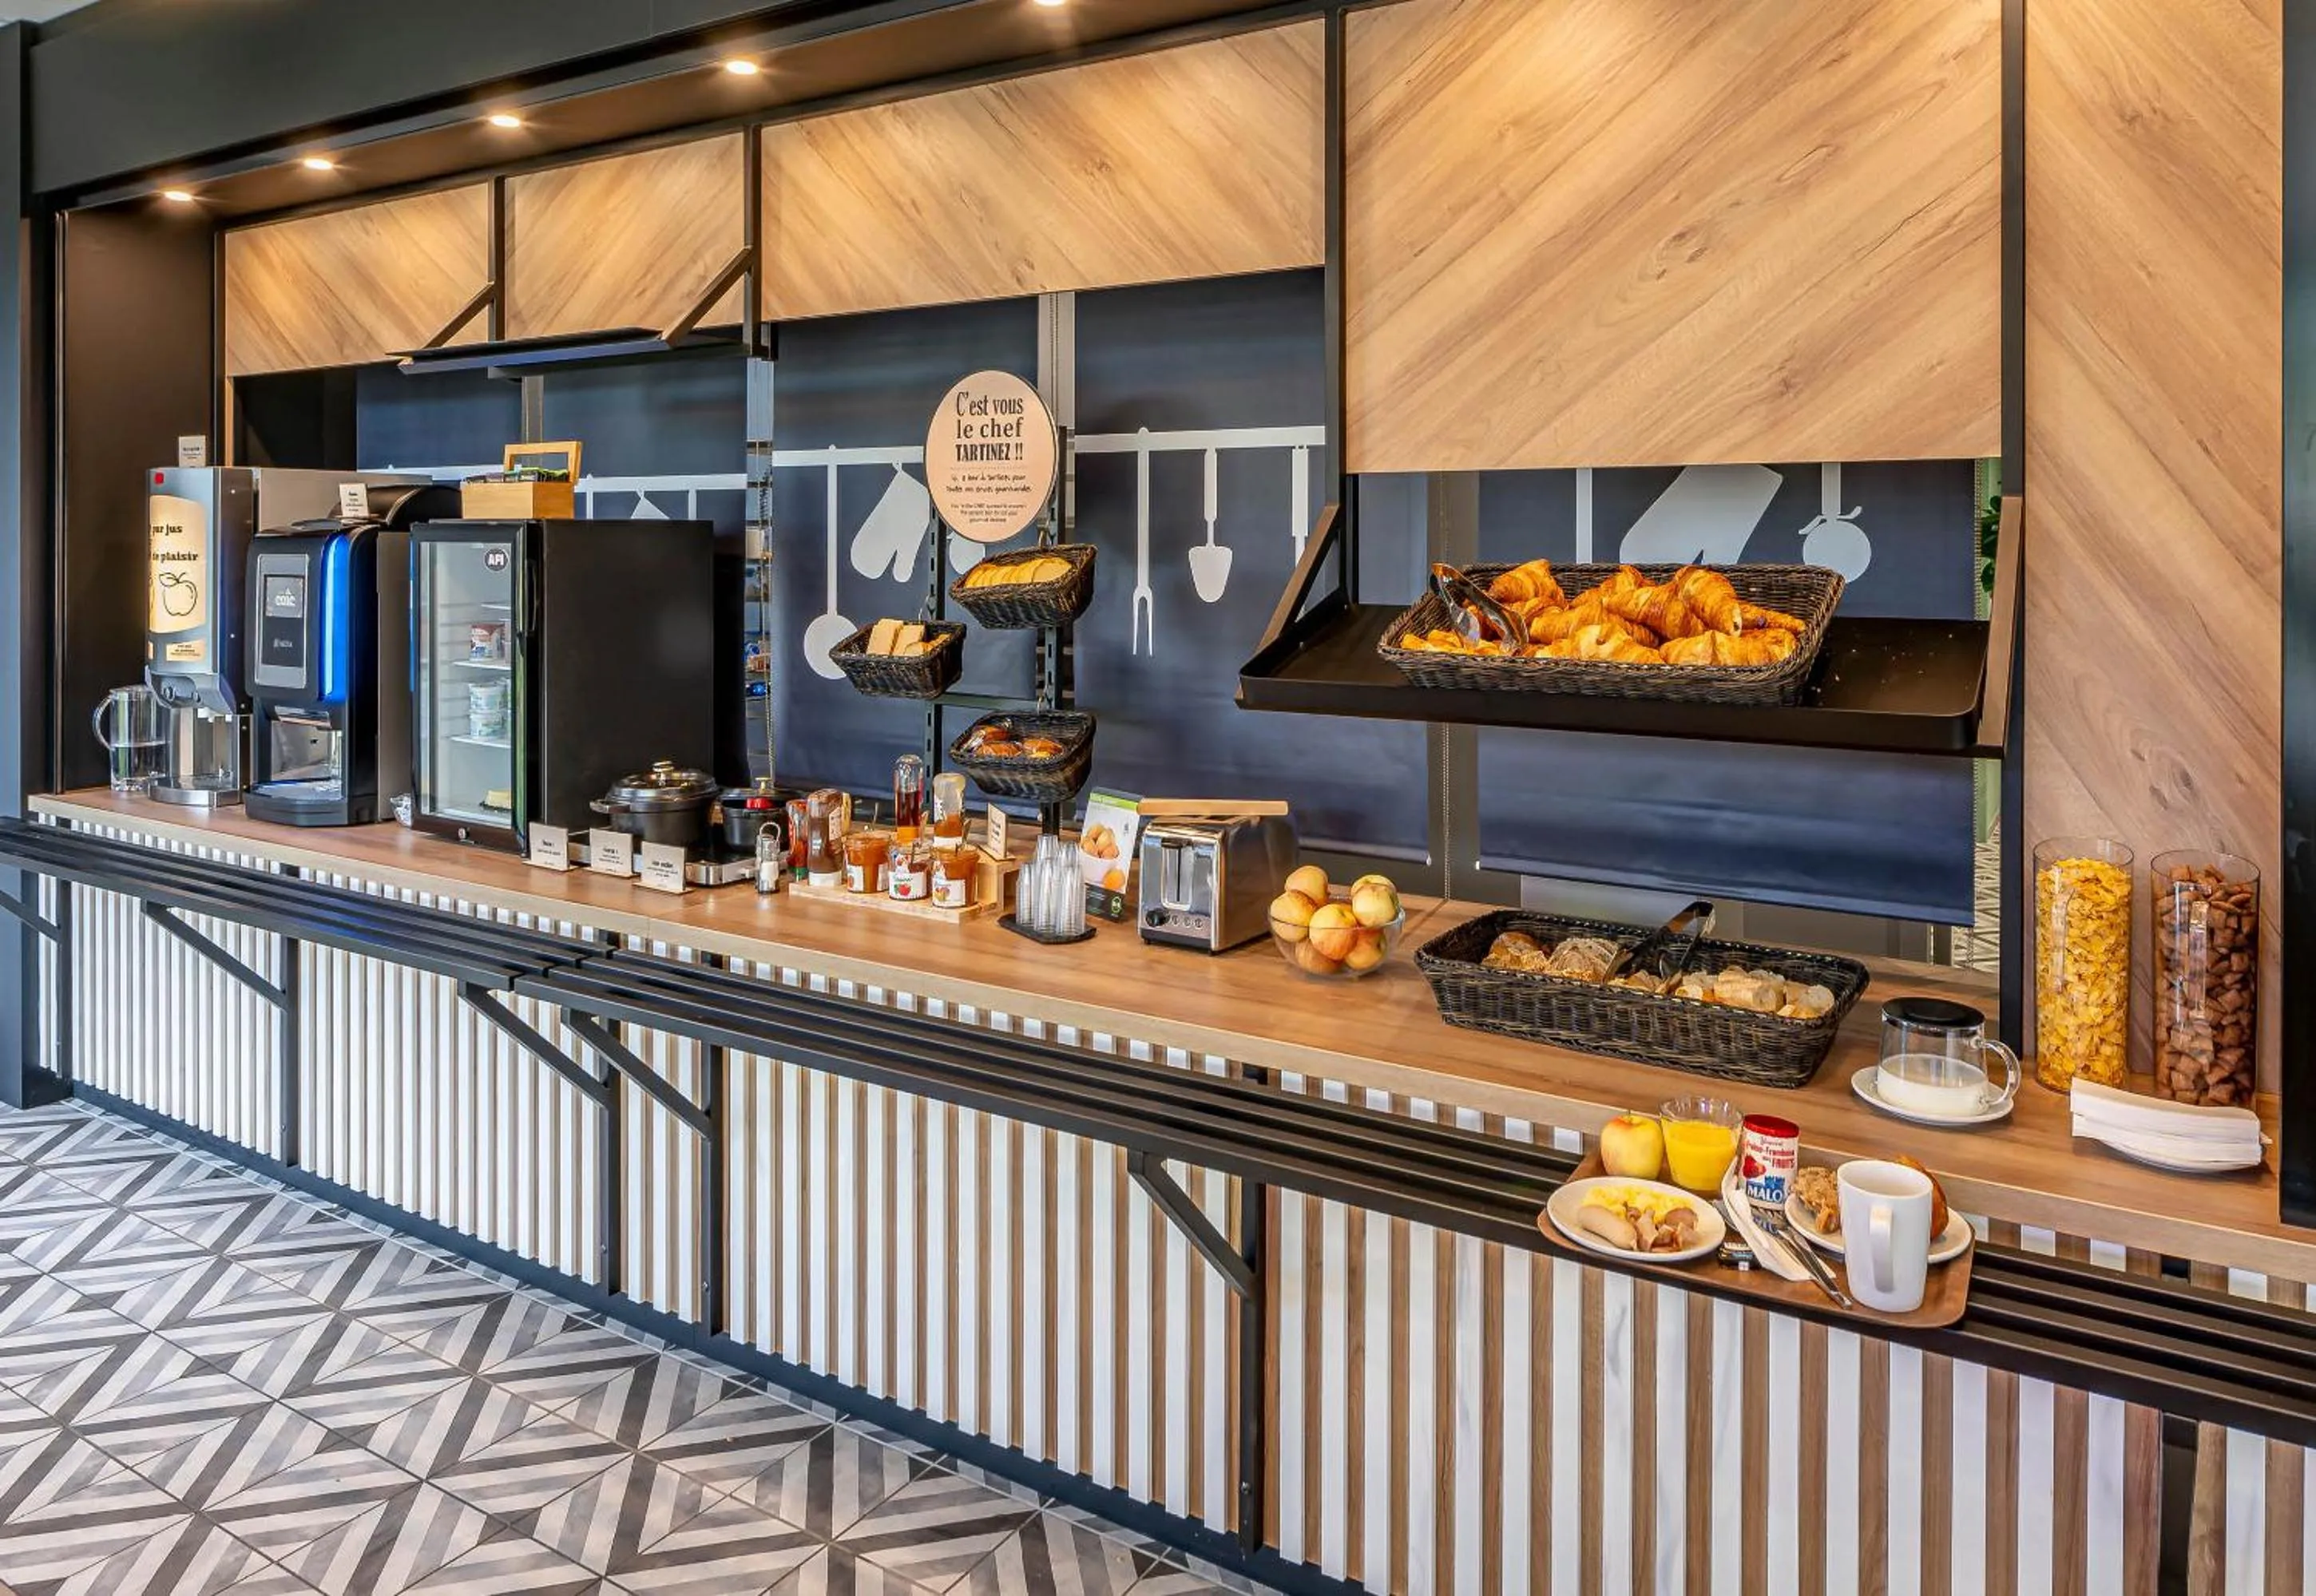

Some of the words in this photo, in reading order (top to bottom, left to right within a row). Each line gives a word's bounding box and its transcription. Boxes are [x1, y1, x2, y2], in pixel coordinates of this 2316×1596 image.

[957, 390, 989, 417] C'est
[993, 398, 1024, 415] vous
[957, 419, 974, 438] le
[980, 417, 1024, 438] chef
[955, 442, 1010, 461] TARTINEZ
[165, 524, 183, 536] jus
[161, 551, 198, 563] plaisir
[1747, 1185, 1783, 1202] MALO
